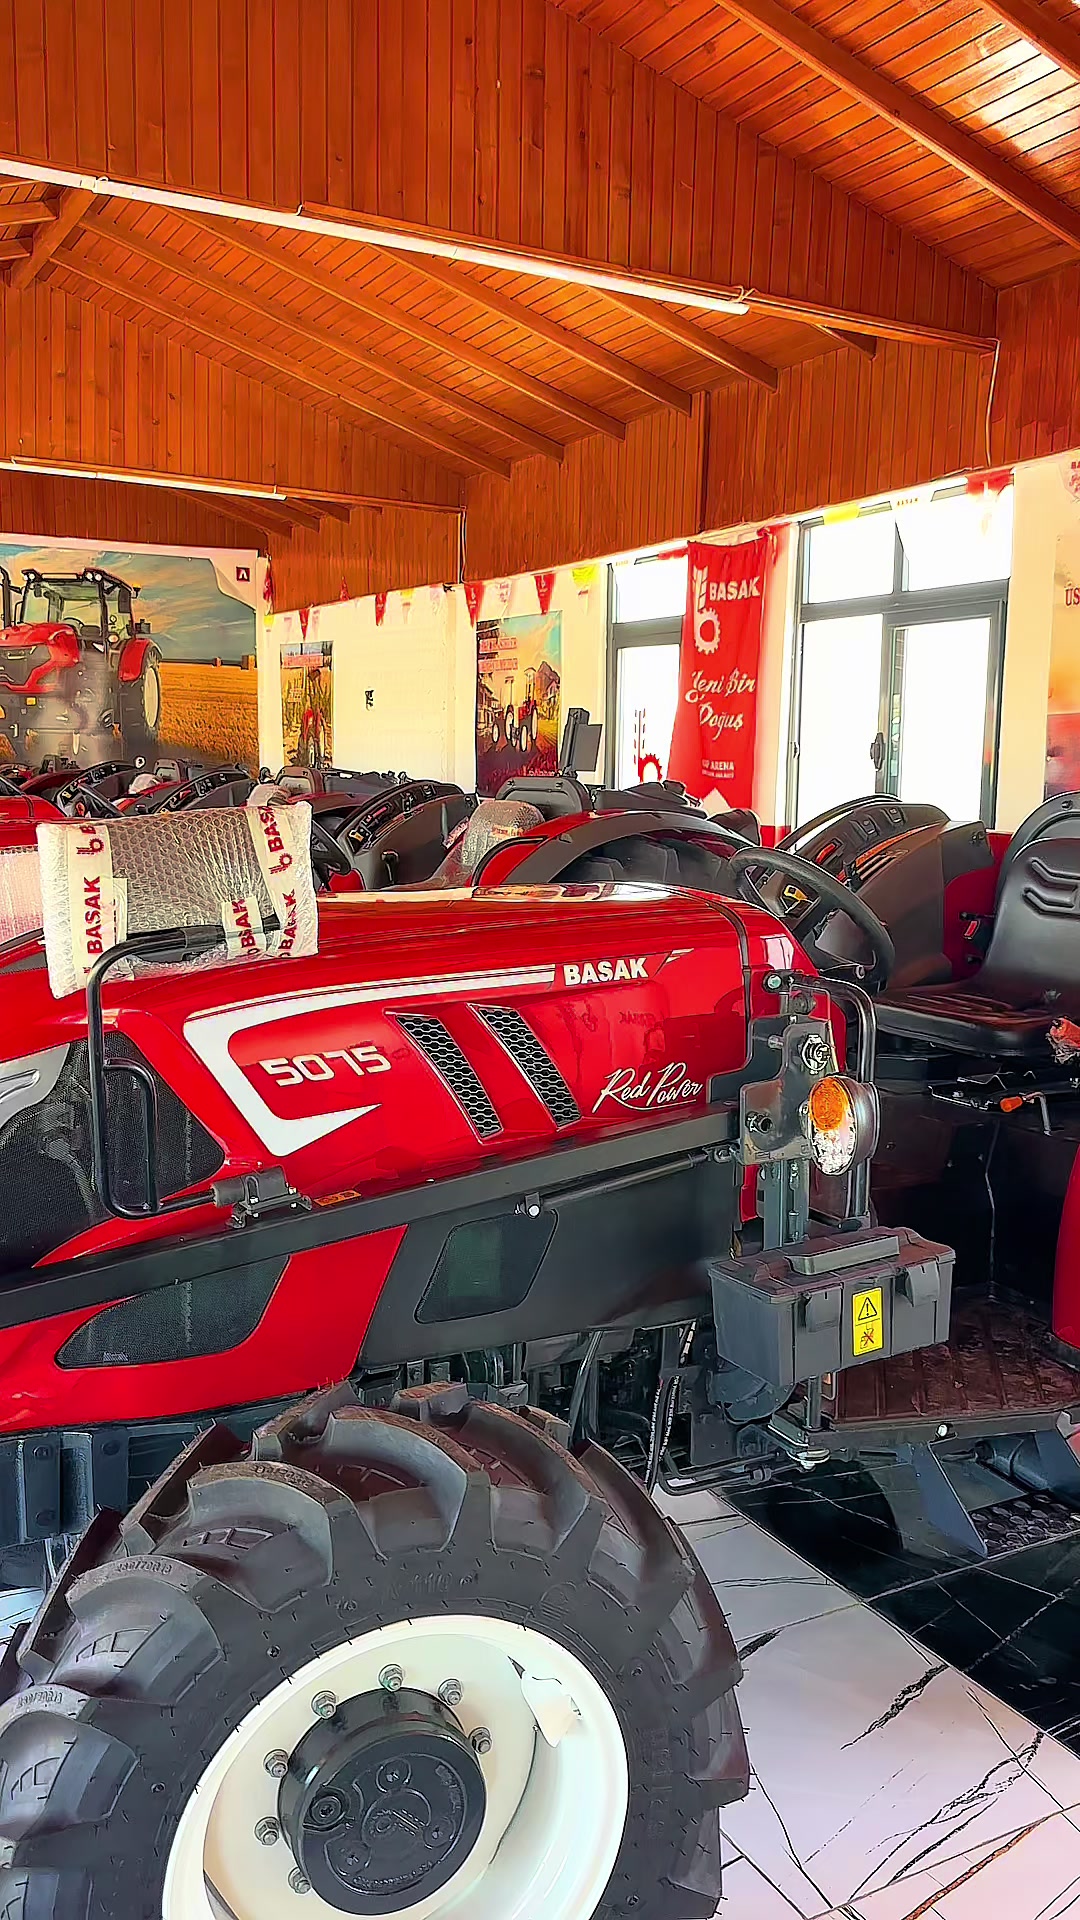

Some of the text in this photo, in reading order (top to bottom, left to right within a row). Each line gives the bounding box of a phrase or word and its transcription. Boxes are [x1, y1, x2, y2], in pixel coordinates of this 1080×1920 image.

[709, 576, 760, 602] BASAK
[684, 667, 756, 704] Yeni Bir
[699, 701, 744, 741] Doğuş
[83, 876, 104, 954] BASAK
[563, 957, 649, 987] BASAK
[258, 1045, 392, 1087] 5075
[591, 1061, 704, 1114] Red Power
